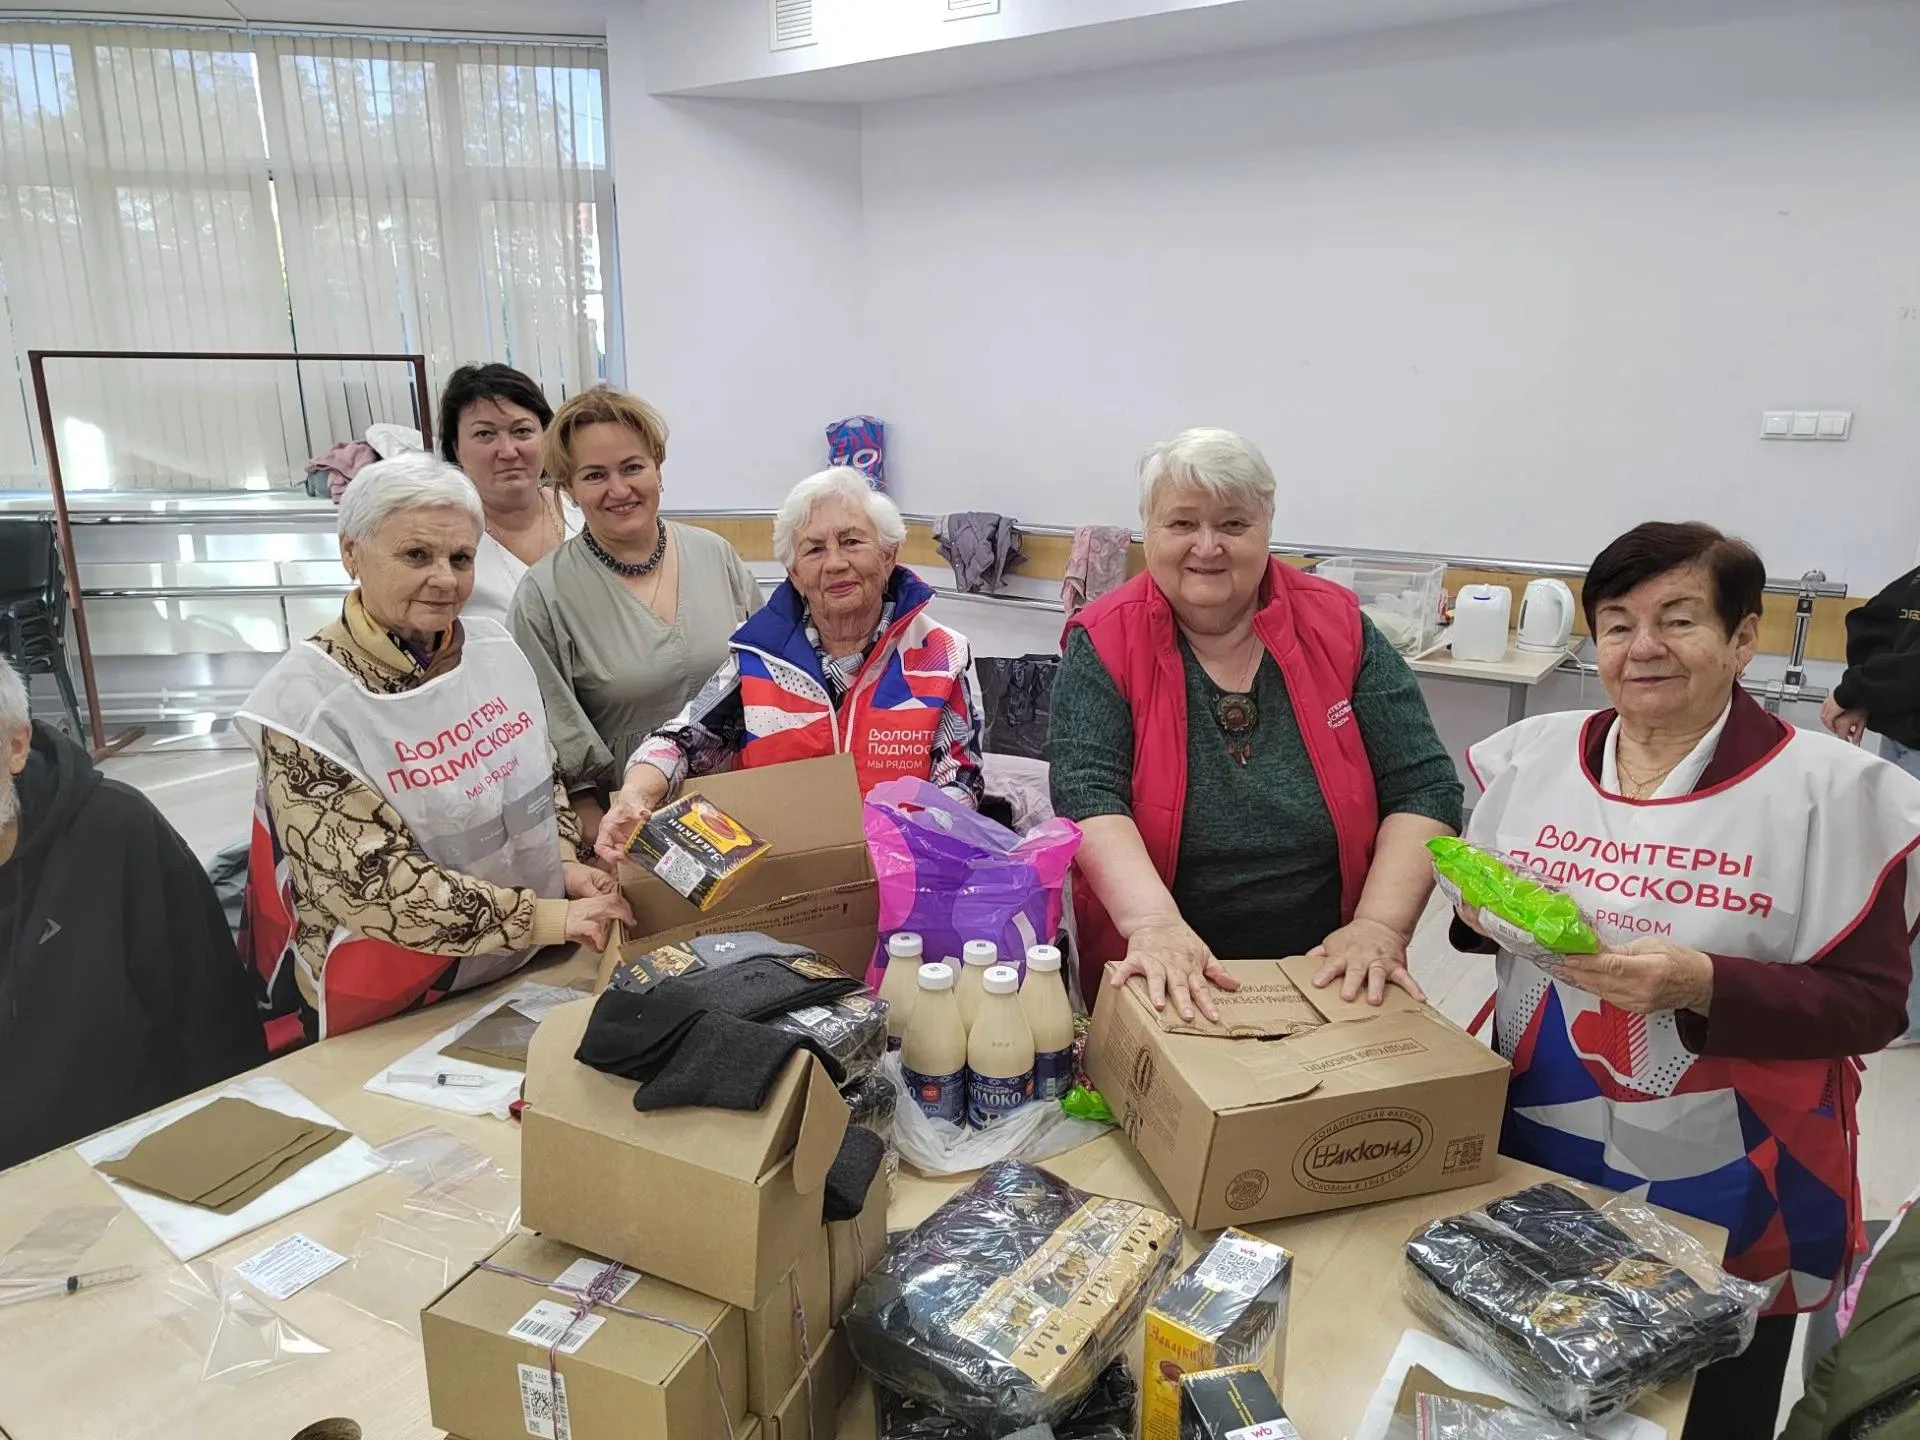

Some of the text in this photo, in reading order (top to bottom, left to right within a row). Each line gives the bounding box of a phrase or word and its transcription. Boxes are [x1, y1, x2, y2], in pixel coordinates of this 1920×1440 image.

[867, 760, 923, 771] МЫ РЯДОМ
[1535, 824, 1753, 878] ВОЛОНТЕРЫ
[1596, 909, 1672, 936] РЯДОМ
[1251, 1426, 1273, 1439] wb
